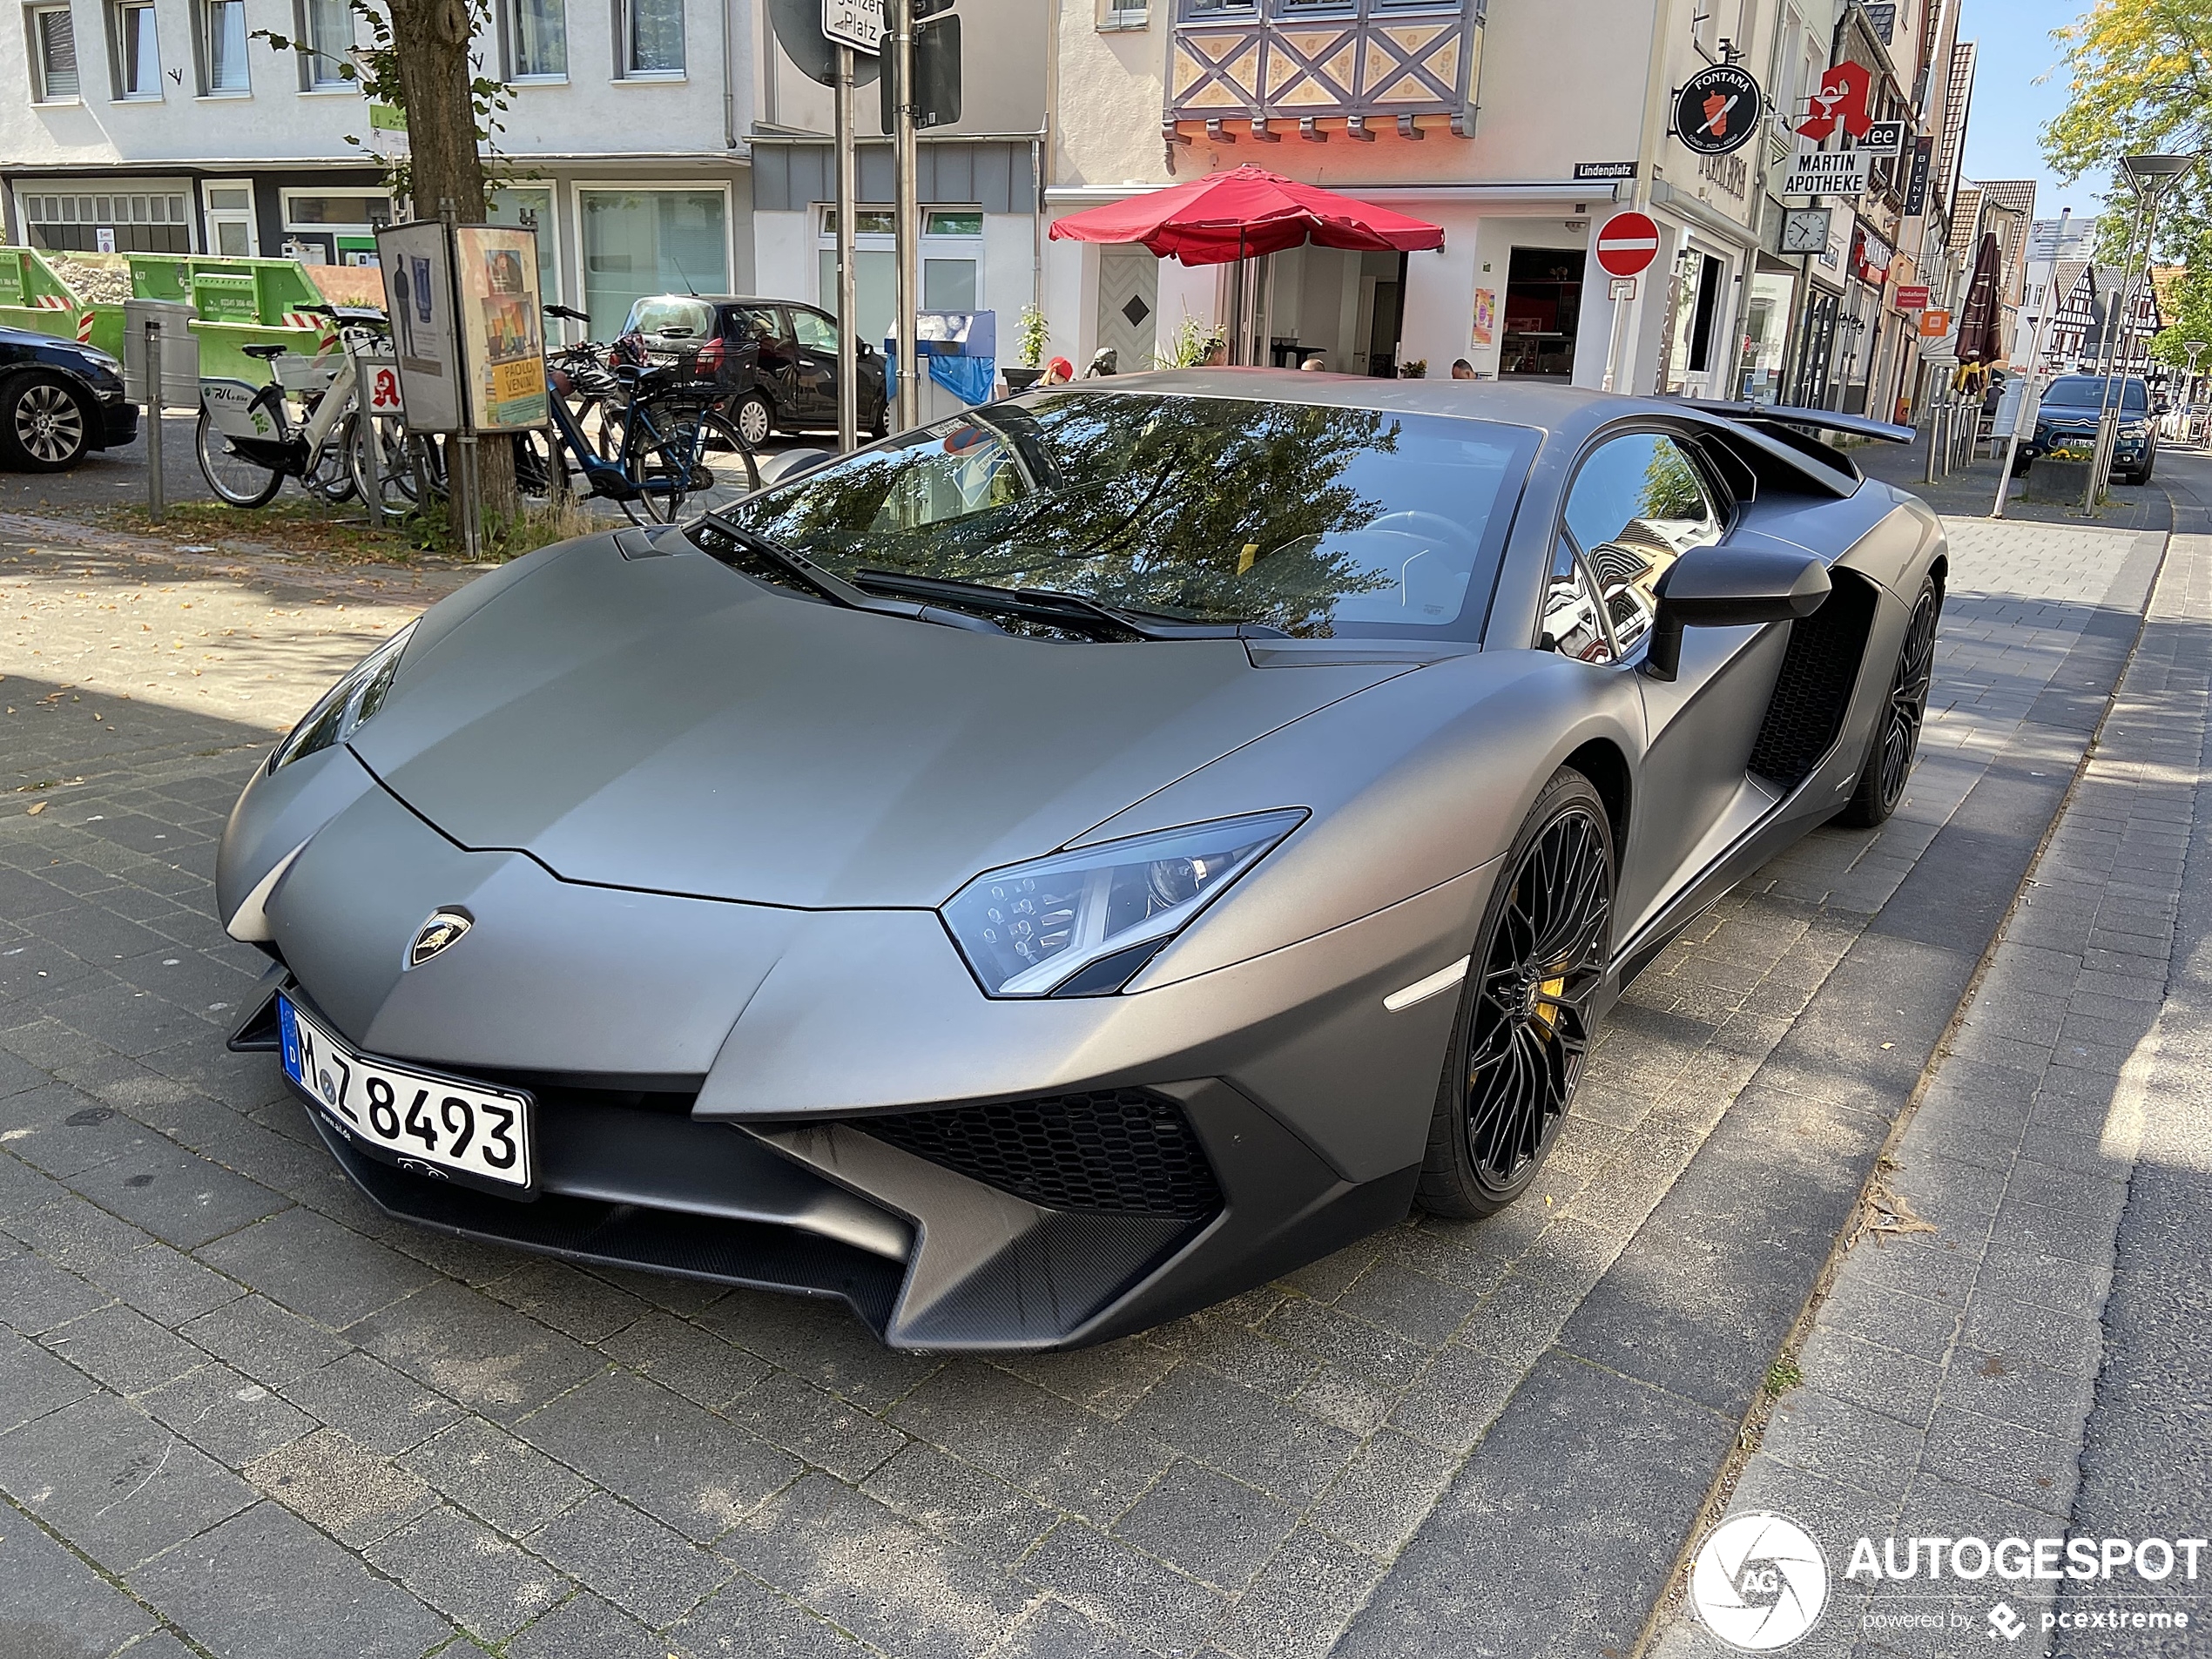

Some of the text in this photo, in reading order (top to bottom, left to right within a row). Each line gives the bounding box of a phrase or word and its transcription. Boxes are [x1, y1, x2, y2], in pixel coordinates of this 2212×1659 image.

[845, 10, 877, 41] Platz
[1695, 72, 1750, 92] FONTANA
[1579, 164, 1632, 177] Lindenplatz
[1798, 154, 1856, 172] MARTIN
[1784, 174, 1864, 192] APOTHEKE
[366, 1076, 517, 1170] 8493
